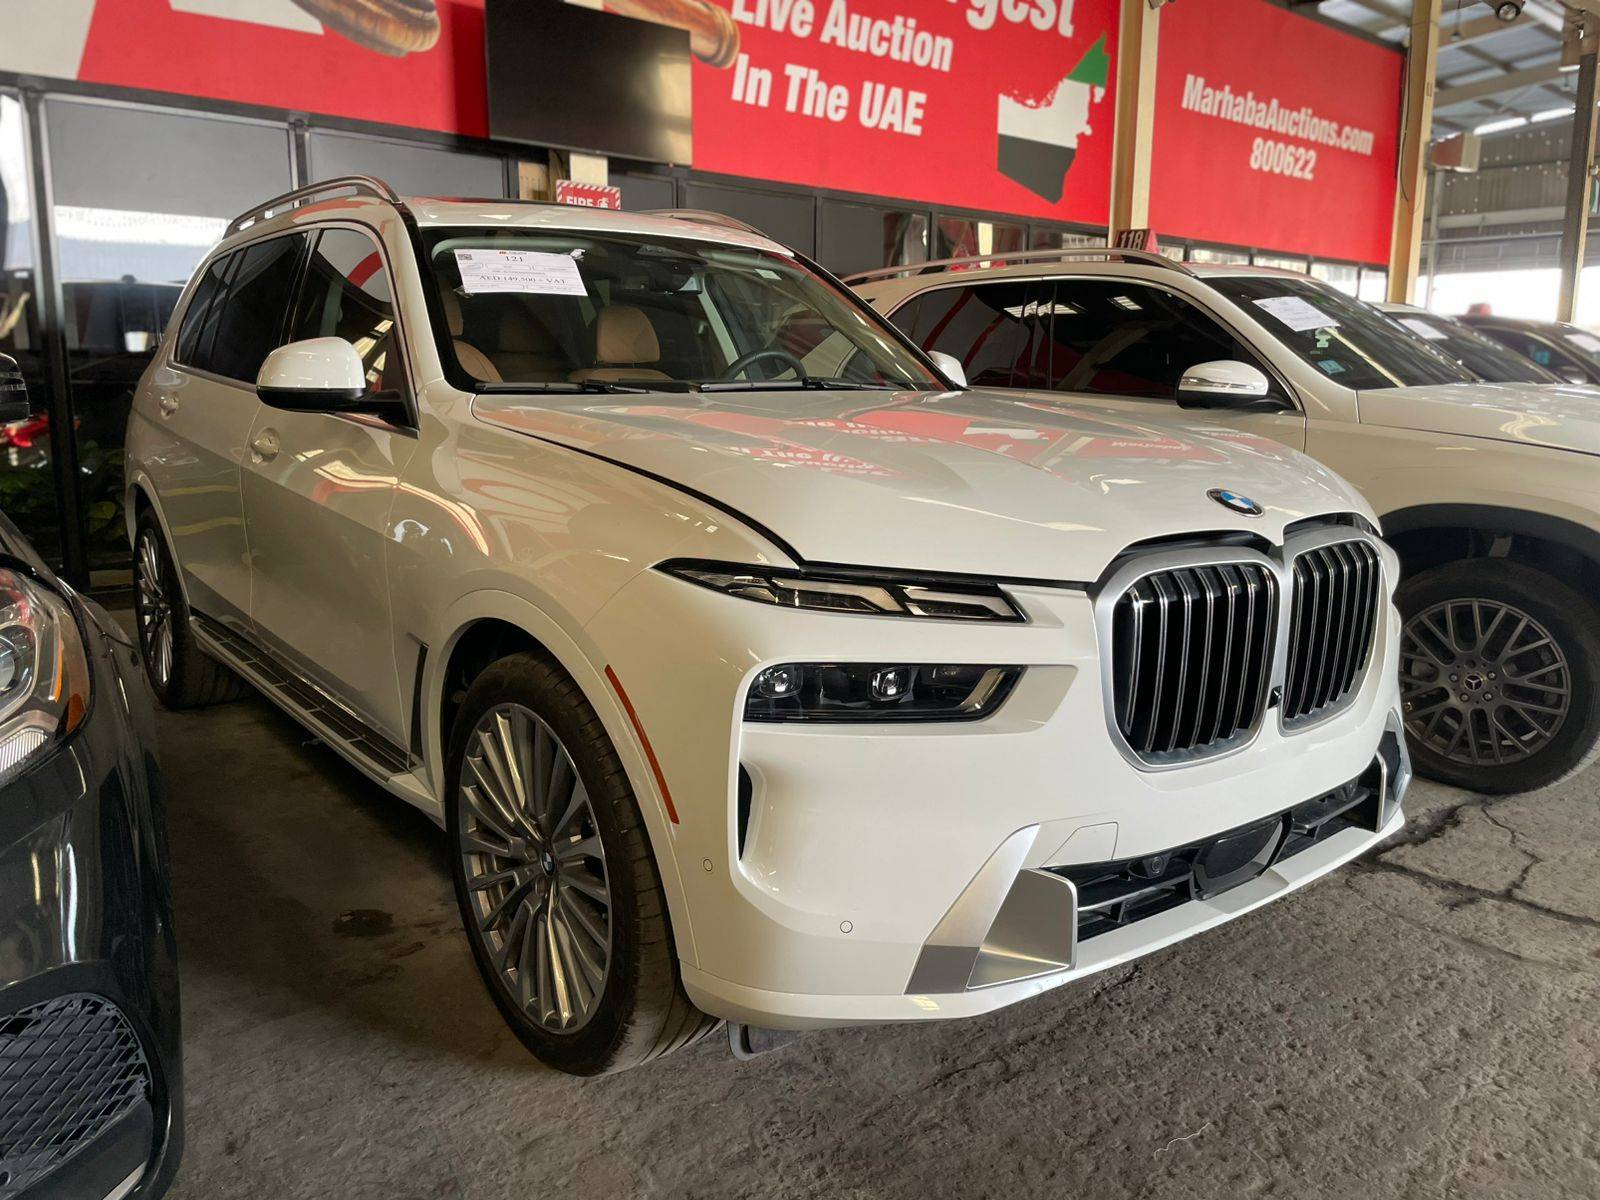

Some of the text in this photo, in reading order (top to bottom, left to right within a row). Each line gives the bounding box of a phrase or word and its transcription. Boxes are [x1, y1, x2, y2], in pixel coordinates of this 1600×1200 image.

[819, 0, 954, 72] Auction
[731, 53, 927, 136] In The UAE
[1181, 73, 1374, 156] MarhabaAuctions.com
[1250, 136, 1317, 181] 800622
[1120, 230, 1144, 250] 118
